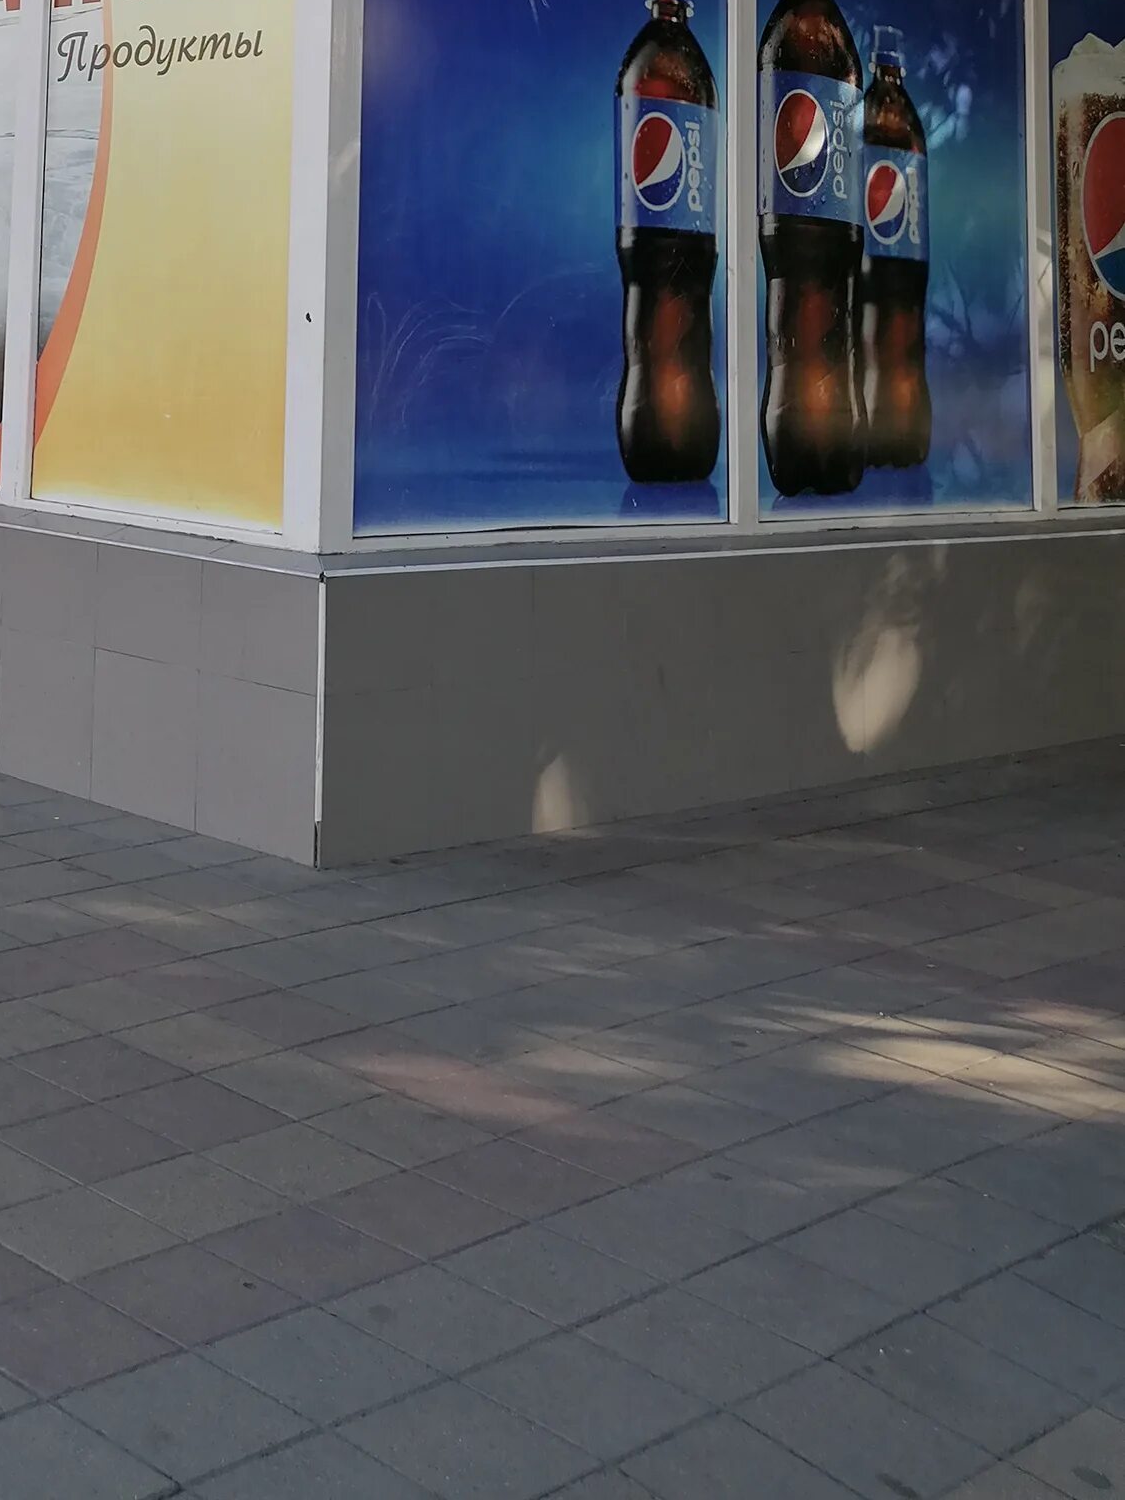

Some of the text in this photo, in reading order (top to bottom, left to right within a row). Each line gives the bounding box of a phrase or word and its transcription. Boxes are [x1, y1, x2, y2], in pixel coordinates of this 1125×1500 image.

[57, 25, 263, 82] Продукты
[685, 121, 704, 213] pepsi
[830, 100, 848, 200] pepsi
